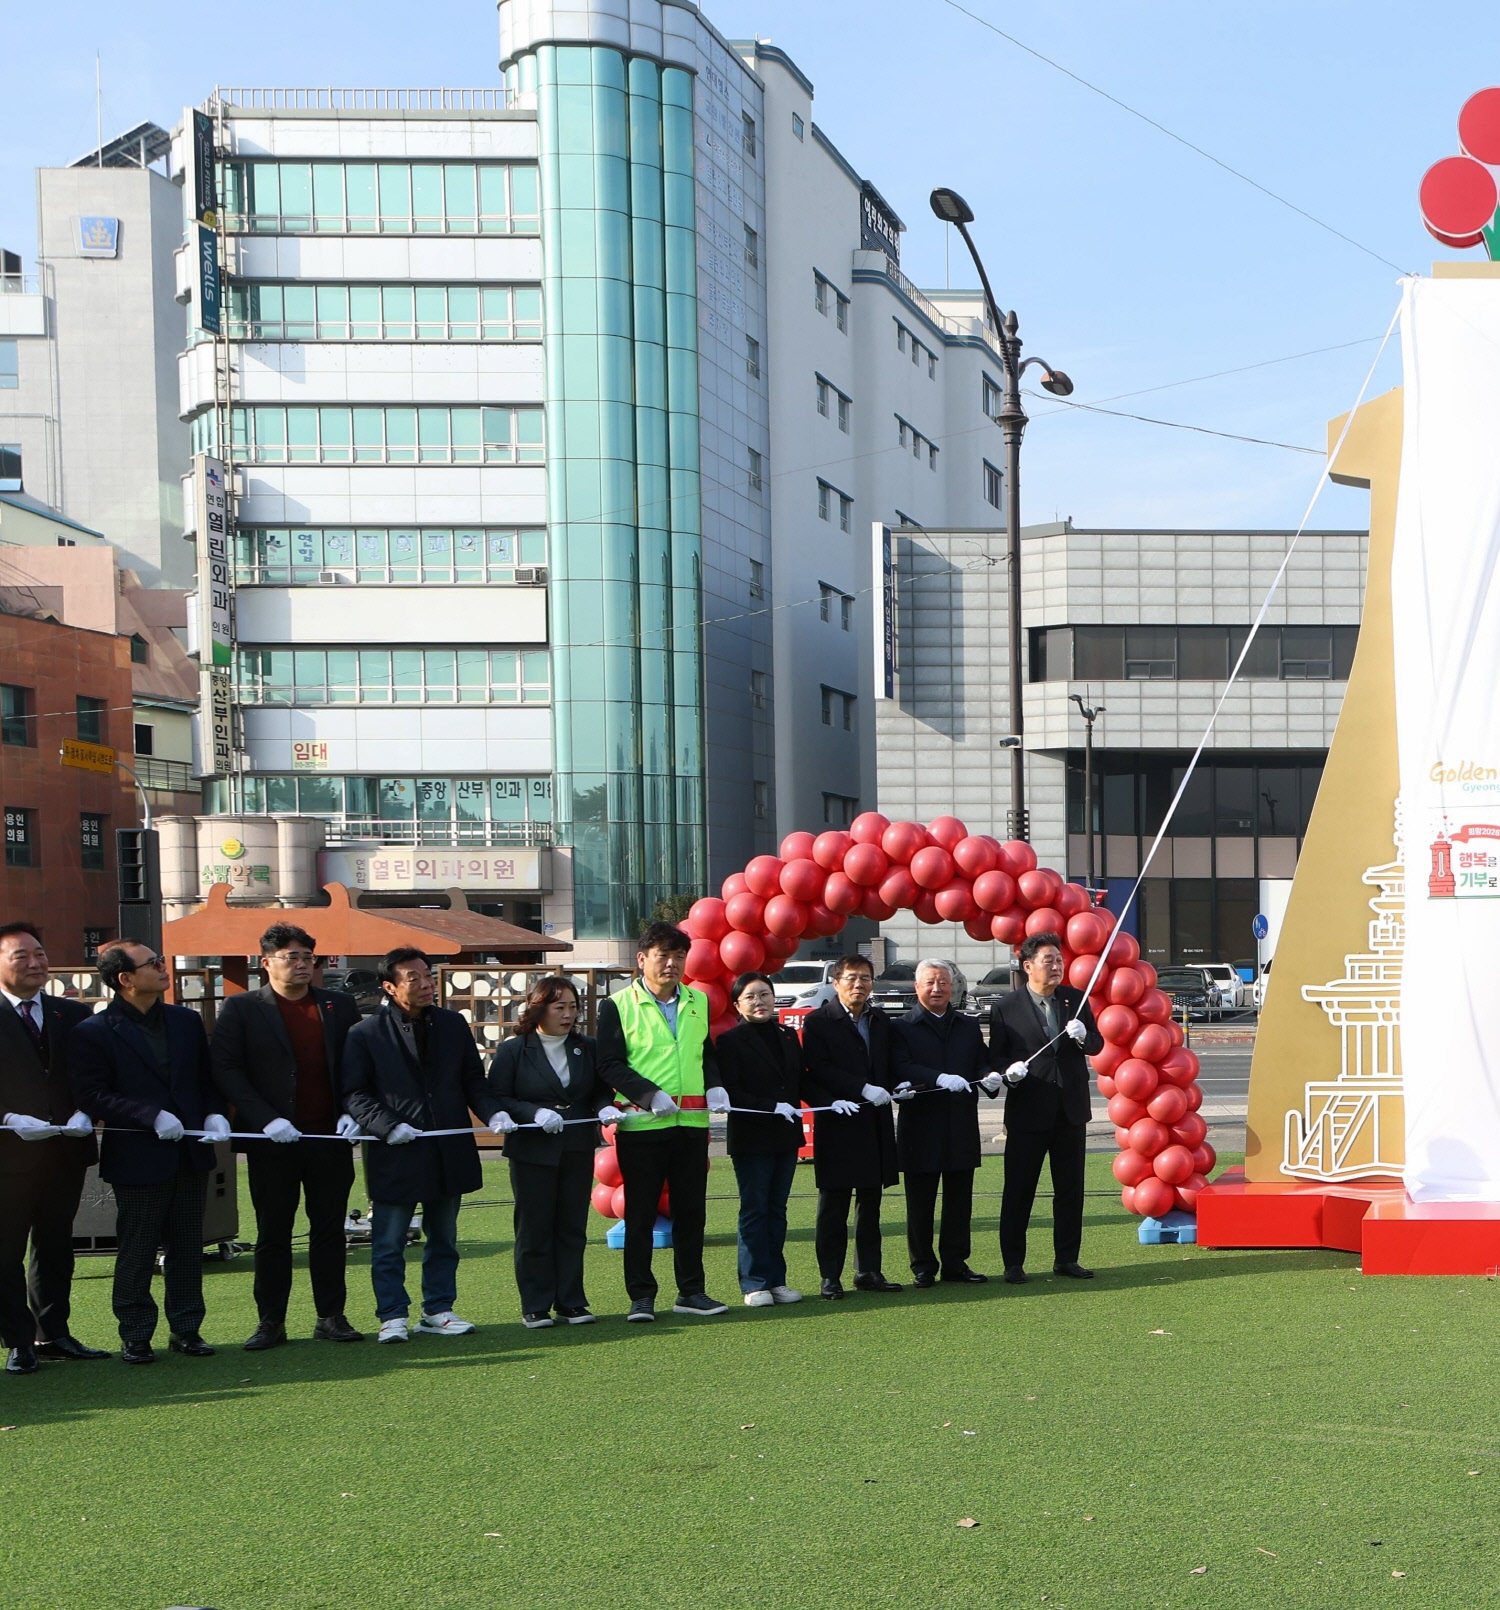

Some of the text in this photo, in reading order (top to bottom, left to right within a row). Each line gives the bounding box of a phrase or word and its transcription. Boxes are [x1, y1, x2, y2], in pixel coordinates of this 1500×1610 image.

[206, 493, 230, 635] 연합 열린외과 의원
[212, 675, 231, 771] 중앙 산부인과 의원
[294, 743, 328, 761] 임대
[1429, 760, 1497, 785] Golden
[421, 782, 447, 800] 중앙
[457, 781, 484, 799] 산부
[495, 781, 521, 799] 인과
[7, 829, 25, 842] 의원
[83, 834, 99, 846] 의원
[1459, 851, 1498, 869] 행복을
[201, 865, 271, 886] 소망약국
[356, 859, 515, 884] 연합 열린외과의원
[1460, 872, 1498, 888] 기부로
